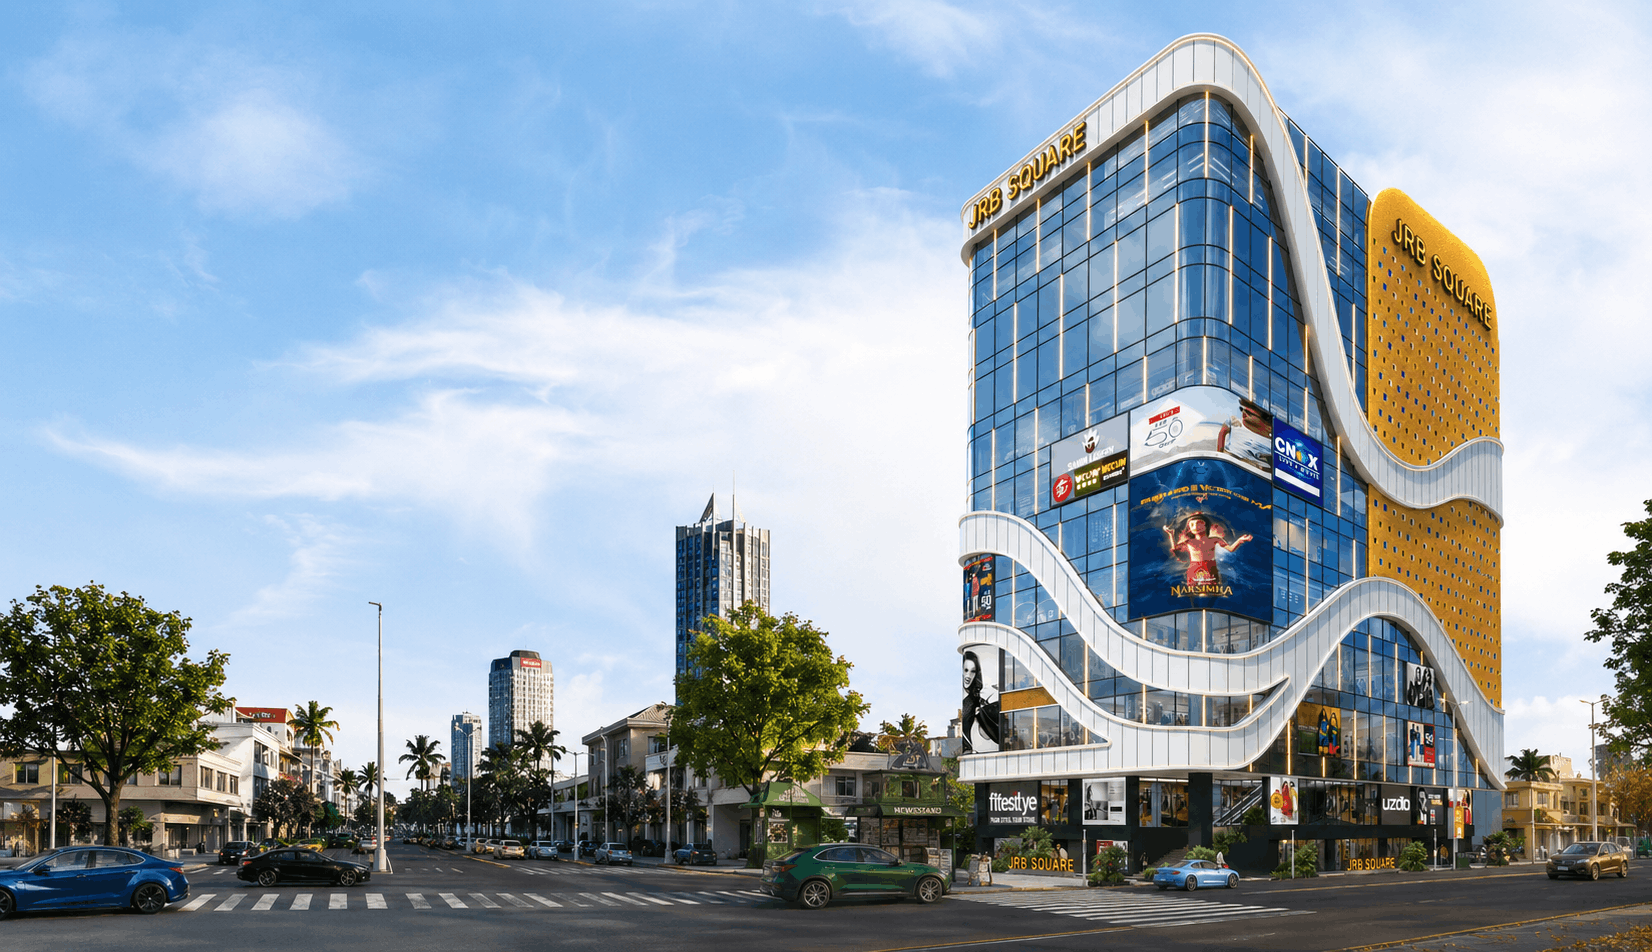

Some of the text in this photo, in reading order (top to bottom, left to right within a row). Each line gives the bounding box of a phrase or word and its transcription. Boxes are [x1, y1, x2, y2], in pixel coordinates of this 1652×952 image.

[968, 121, 1087, 229] JRB SQUARE
[1392, 218, 1492, 331] JRB SQUARE
[1008, 856, 1028, 870] JRB
